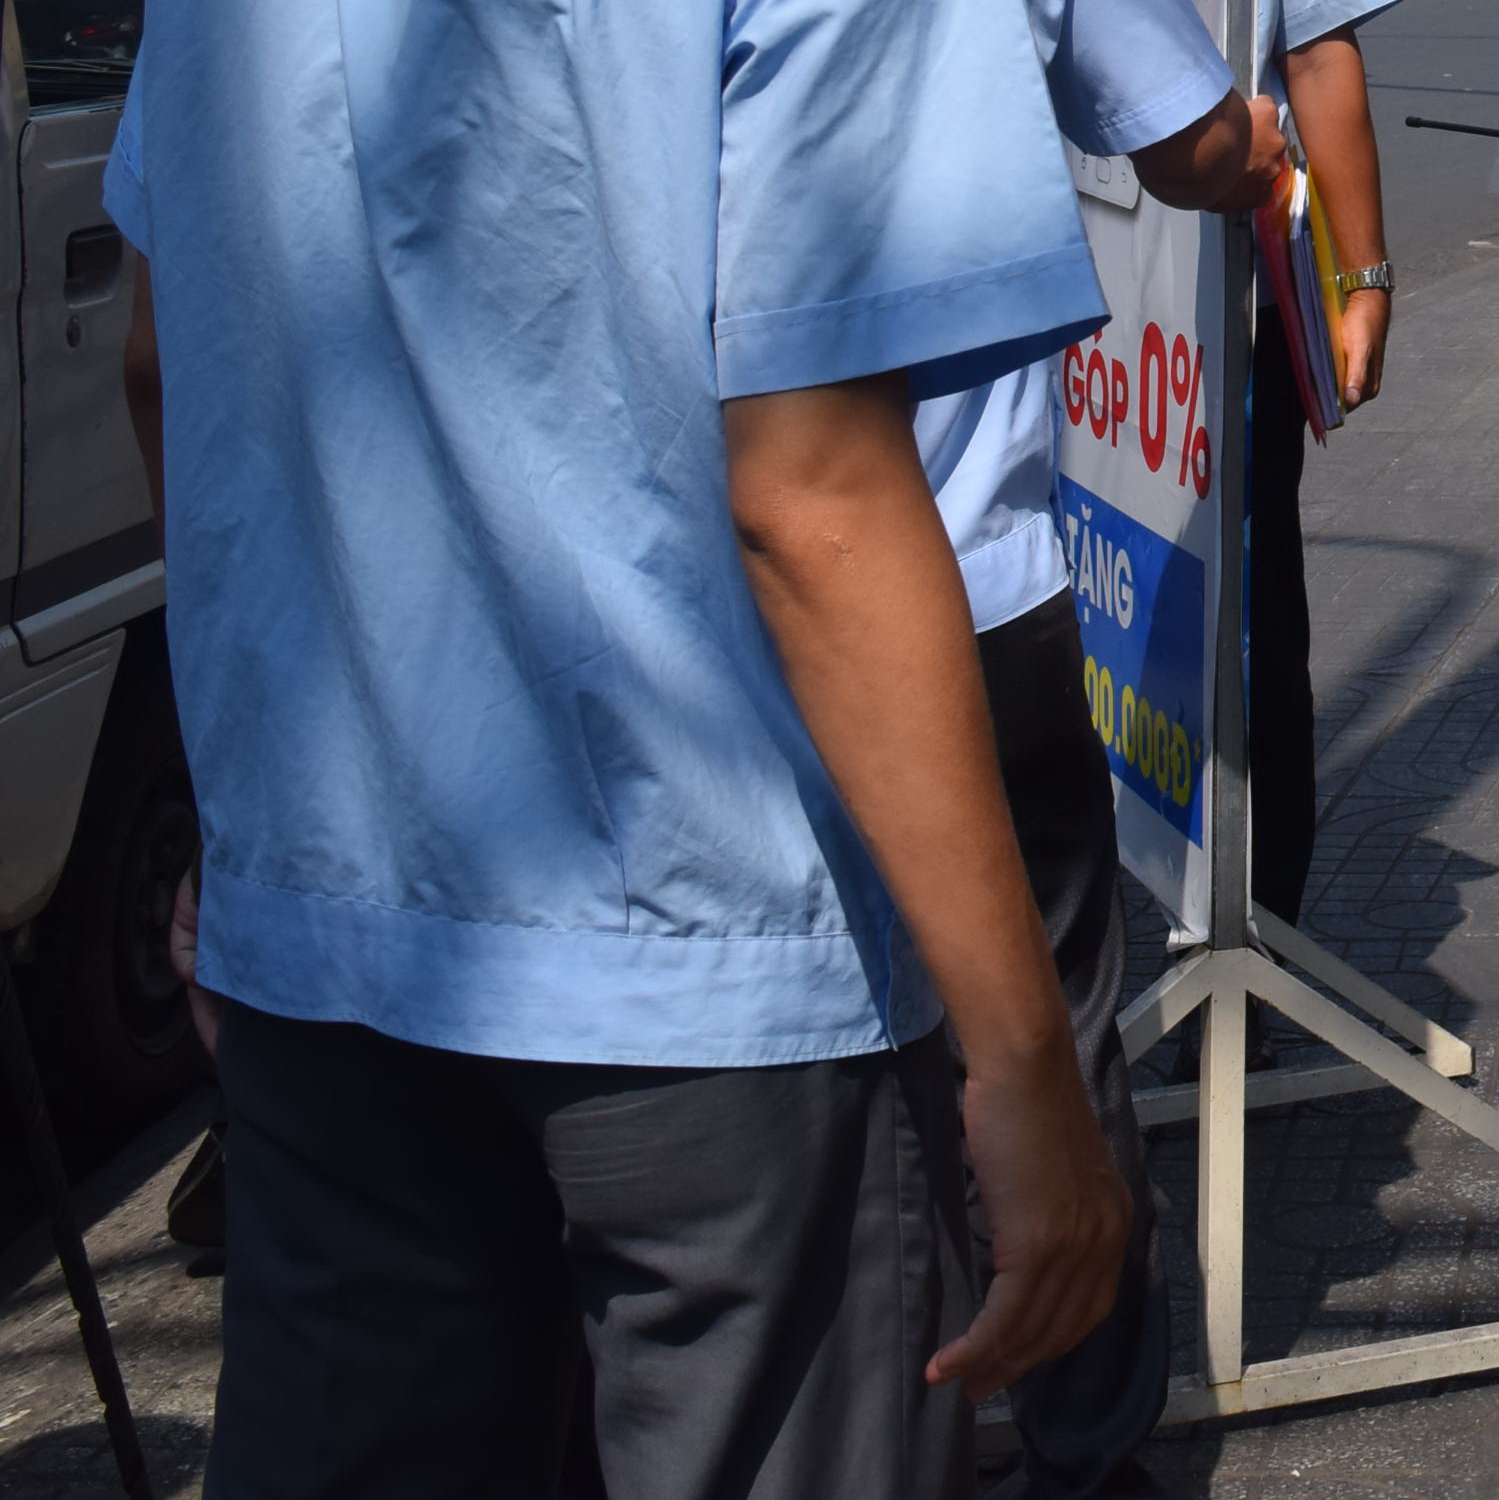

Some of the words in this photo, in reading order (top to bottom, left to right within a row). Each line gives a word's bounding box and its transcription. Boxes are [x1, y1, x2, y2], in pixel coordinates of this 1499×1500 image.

[1063, 327, 1129, 448] GÓP
[1138, 321, 1211, 500] 0%
[1066, 503, 1134, 629] TẶNG
[1084, 655, 1202, 808] 00.000Đ
